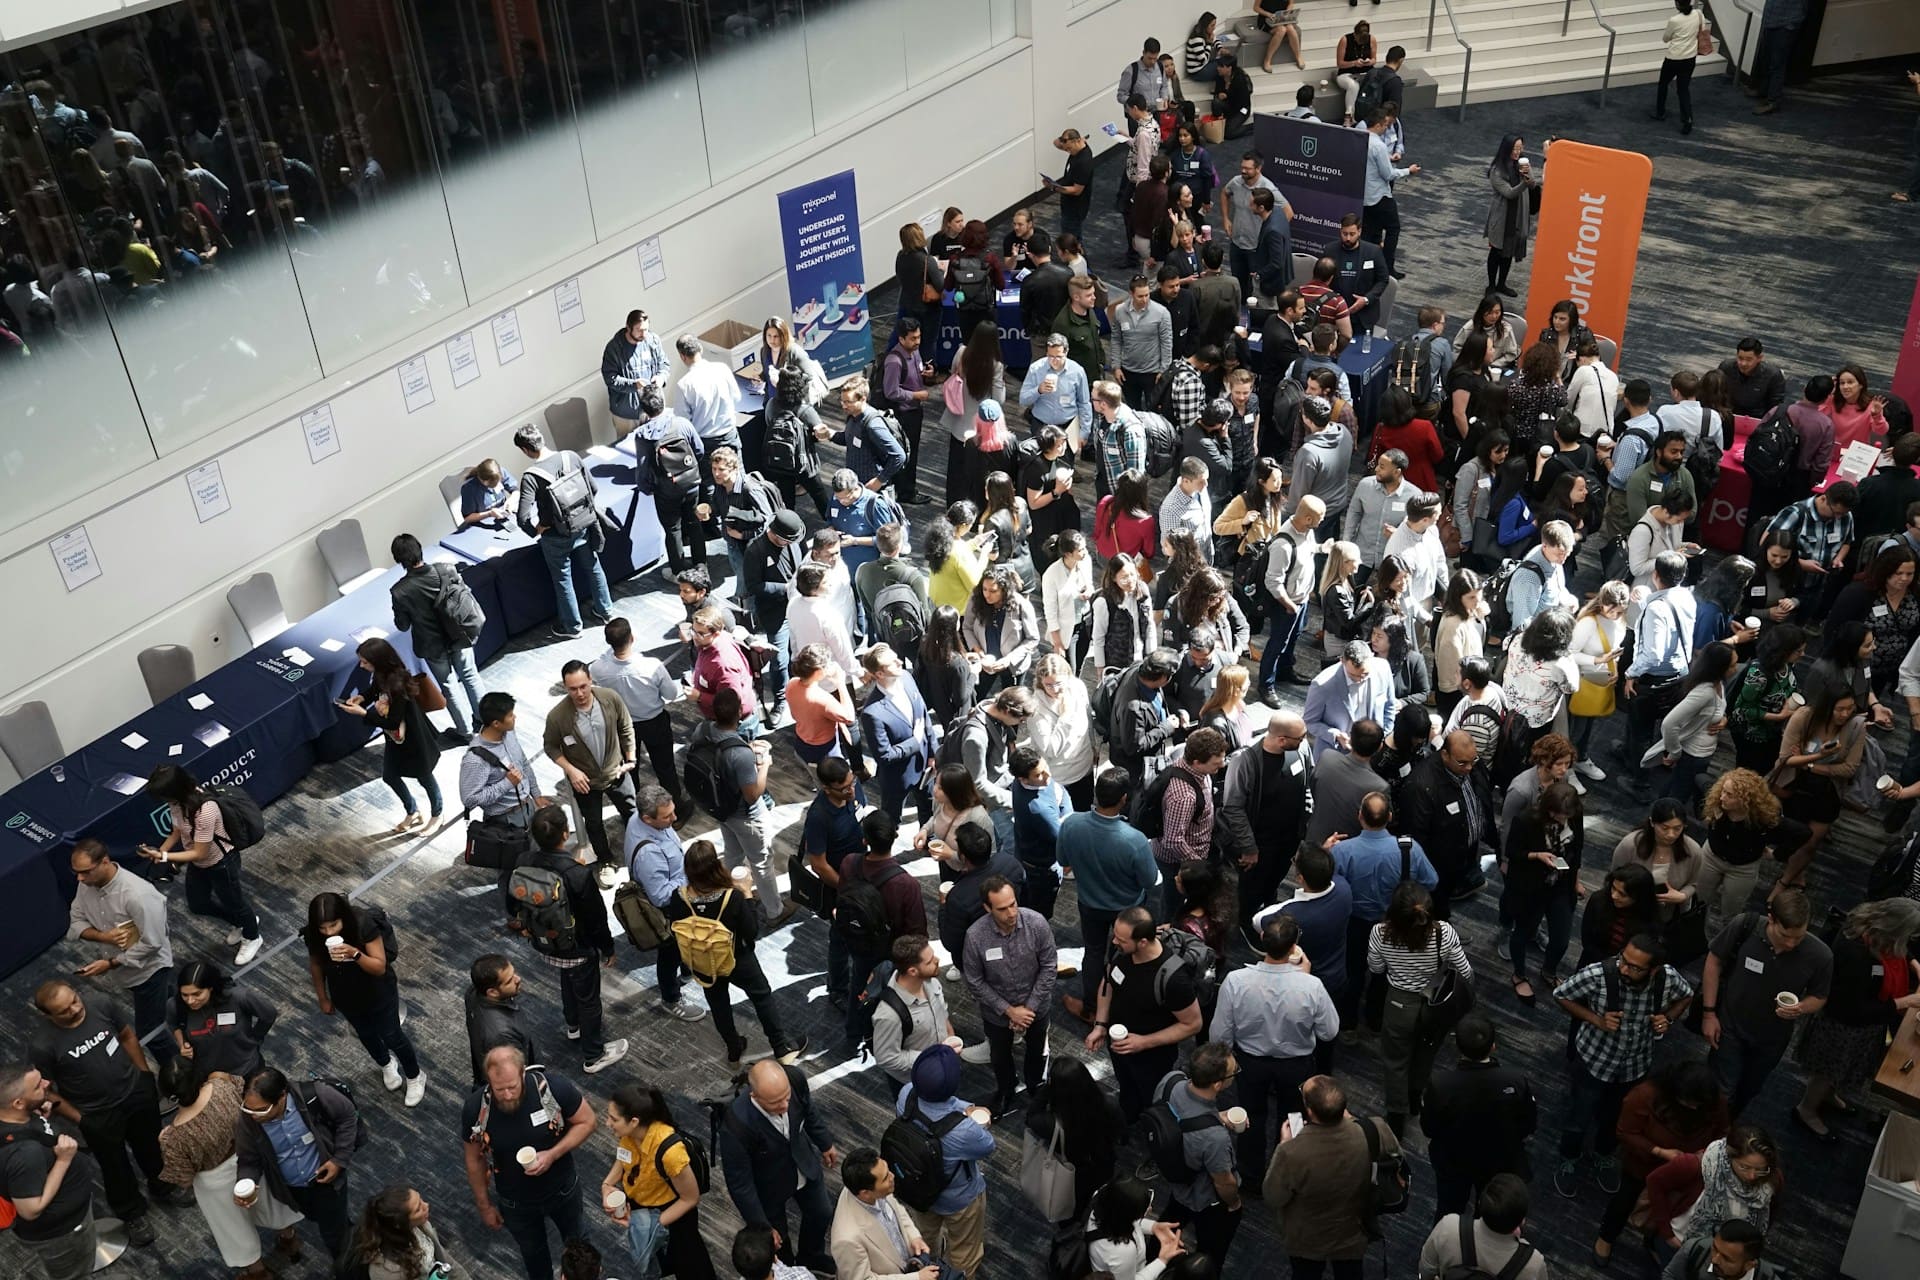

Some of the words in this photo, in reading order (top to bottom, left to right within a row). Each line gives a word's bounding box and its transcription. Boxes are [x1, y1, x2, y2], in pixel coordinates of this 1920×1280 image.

[1274, 157, 1310, 170] PRODUCT
[1312, 164, 1342, 176] SCHOOL
[1286, 169, 1307, 177] SILICON
[1309, 173, 1329, 182] VALLEY
[802, 191, 837, 210] mixpanel
[798, 213, 845, 235] UNDERSTAND
[1298, 213, 1323, 225] Product
[1322, 219, 1342, 229] Mana
[800, 232, 822, 247] EVERY
[822, 225, 847, 239] USER'S
[799, 241, 831, 259] JOURNEY
[831, 235, 850, 249] WITH
[795, 255, 825, 271] INSTANT
[824, 244, 856, 262] INSIGHTS
[1565, 191, 1607, 326] orkfront
[201, 748, 256, 788] ODUCT
[20, 827, 43, 843] SCHOOL
[28, 821, 56, 839] PRODUCT
